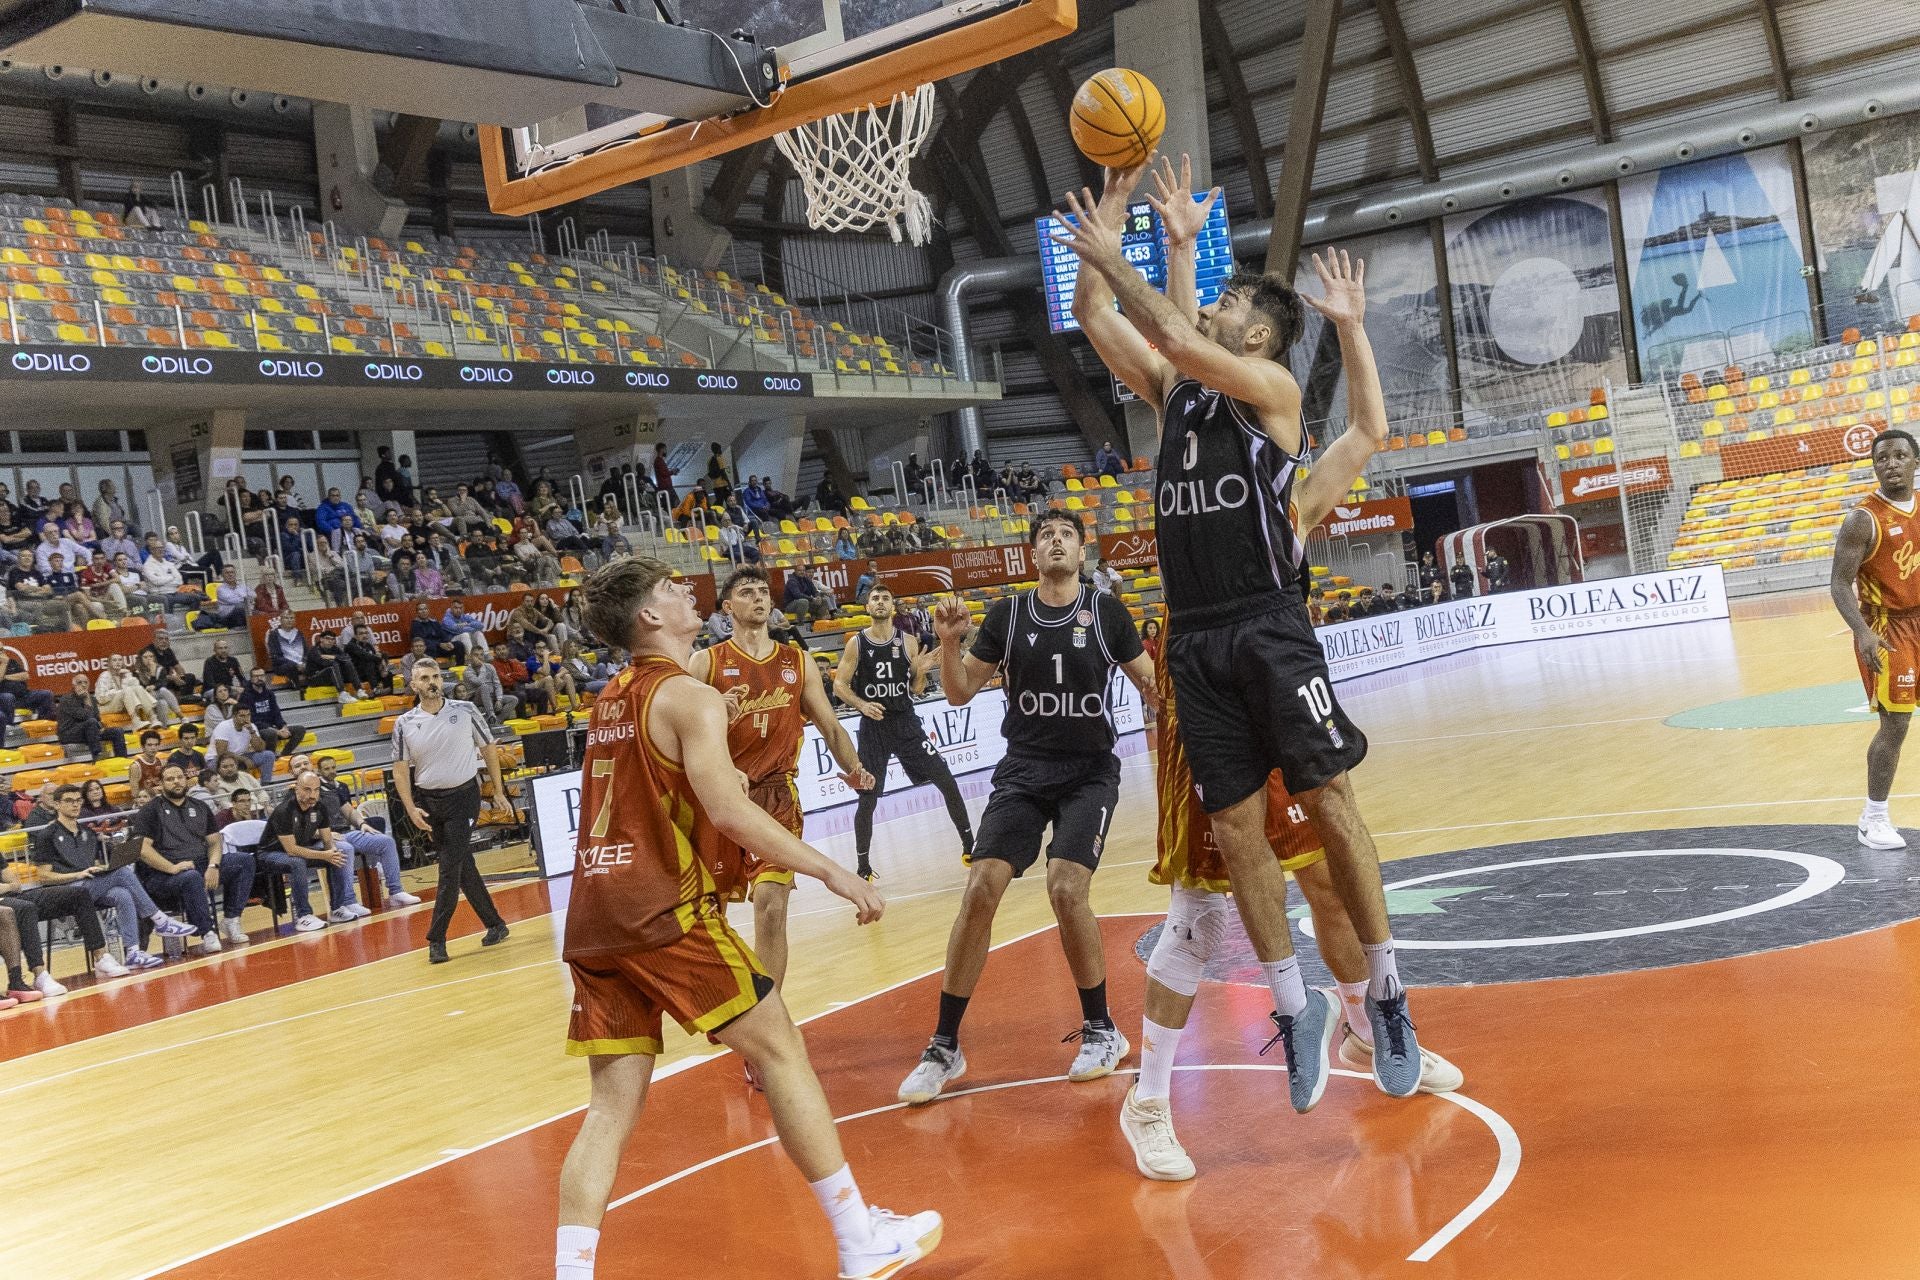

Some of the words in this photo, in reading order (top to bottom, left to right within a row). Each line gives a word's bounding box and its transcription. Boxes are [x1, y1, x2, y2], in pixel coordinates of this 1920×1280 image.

[1132, 204, 1150, 215] GODE
[1135, 216, 1150, 231] 26
[12, 352, 91, 372] ODILO
[142, 355, 213, 375] ODILO
[259, 359, 323, 377] ODILO
[365, 363, 423, 380] ODILO
[460, 366, 513, 383] ODILO
[547, 369, 595, 385] ODILO
[625, 371, 670, 387] ODILO
[697, 374, 738, 389] ODILO
[764, 376, 801, 391] ODILO
[1160, 474, 1248, 517] ODILO
[1329, 514, 1395, 535] agriverdes
[952, 554, 965, 568] LOS
[968, 571, 990, 579] HOTEL
[1528, 588, 1625, 620] BOLEA
[1633, 576, 1706, 607] SAEZ
[310, 613, 399, 631] Ayuntiento
[1415, 610, 1455, 641] BOLEA
[1455, 603, 1496, 631] SAEZ
[1533, 620, 1593, 633] SEGUROS
[1616, 605, 1709, 623] REASEGUROS
[1324, 628, 1370, 660] BOLEA
[1371, 620, 1403, 648] SAEZ
[1419, 640, 1444, 654] SEGUROS
[36, 659, 90, 677] REGIÓN
[91, 657, 109, 671] DE
[876, 662, 893, 679] 21
[1051, 654, 1063, 684] 1
[1329, 660, 1358, 675] SEGUROS
[1360, 659, 1365, 667] Y
[1366, 652, 1406, 666] REASEGUROS
[1019, 690, 1103, 718] ODILO
[1298, 676, 1332, 724] 10
[753, 713, 769, 738] 4
[590, 757, 615, 838] 7
